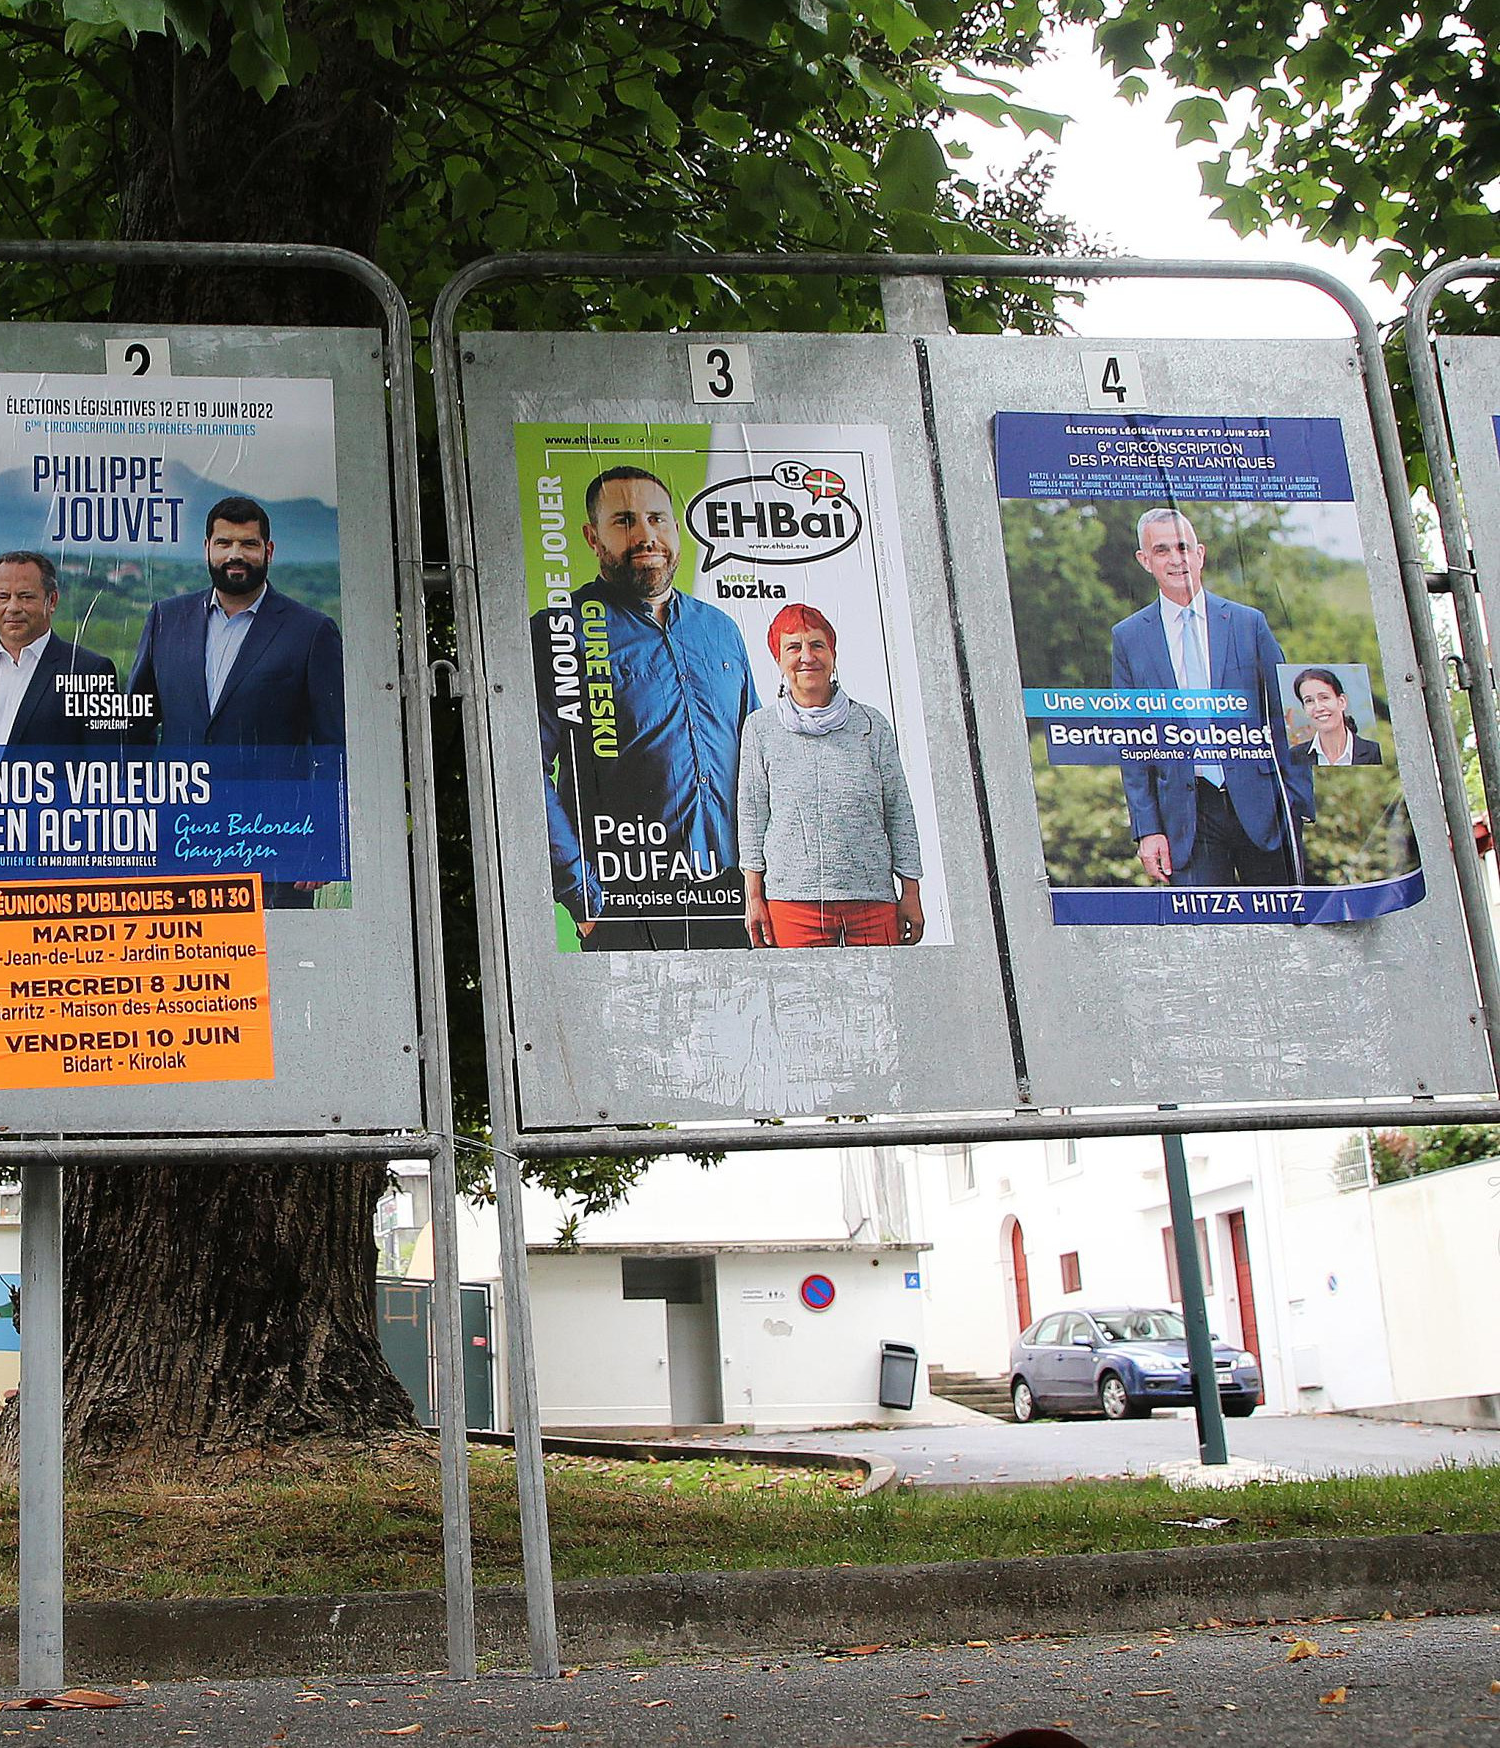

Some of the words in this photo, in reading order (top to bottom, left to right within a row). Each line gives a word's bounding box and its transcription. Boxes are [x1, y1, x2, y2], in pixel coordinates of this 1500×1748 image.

[124, 342, 151, 376] 2
[706, 348, 734, 398] 3
[1100, 357, 1126, 403] 4
[6, 395, 71, 415] ÉLECTIONS
[75, 396, 156, 417] LÉGISLATIVES
[160, 401, 172, 417] 12
[177, 402, 190, 418] ET
[194, 402, 207, 418] 19
[211, 402, 238, 419] JUIN
[241, 403, 273, 419] 2022
[44, 421, 126, 435] CIRCONSCRIPTION
[128, 421, 146, 435] DES
[544, 435, 620, 445] www.ehbai.eus
[1065, 425, 1118, 436] ÉLECTIONS
[1119, 426, 1183, 437] LÉGISLATIVES
[1185, 429, 1196, 437] 12
[1197, 429, 1210, 437] ET
[1224, 429, 1246, 438] JUIN
[1247, 429, 1271, 438] 2022
[1114, 441, 1244, 456] CIRCONSCRIPTION
[1069, 454, 1098, 467] DES
[1101, 452, 1174, 468] PYRÉNÉES
[1177, 456, 1276, 470] ATLANTIQUES
[33, 455, 164, 494] PHILIPPE
[780, 466, 800, 484] 15
[52, 496, 184, 544] JOUVET
[537, 474, 570, 568] JOUER
[705, 499, 846, 539] EHBai
[748, 542, 809, 550] www.ehbai.eus
[716, 579, 787, 599] bozka
[722, 573, 756, 583] votez
[544, 571, 573, 610] DE
[580, 599, 612, 677] GURE
[548, 614, 581, 697] NOUS
[55, 674, 115, 693] PHILIPPE
[65, 694, 154, 717] ELISSALDE
[557, 700, 583, 725] A
[1043, 693, 1085, 711] Une
[1089, 693, 1131, 711] voix
[1135, 693, 1166, 714] qui
[1171, 694, 1248, 714] compte
[90, 718, 128, 730] SUPPLÉANT
[587, 682, 619, 759] ESKU
[1050, 724, 1159, 745] Bertrand
[1164, 724, 1273, 745] Soubelet
[1121, 749, 1185, 760] Suppléante
[1193, 748, 1228, 760] Anne
[65, 761, 211, 805] VALEURS
[39, 808, 157, 852] ACTION
[174, 813, 221, 838] Gure
[227, 812, 315, 837] Baloreak
[593, 814, 668, 846] Peio
[25, 855, 36, 867] DE
[37, 855, 48, 867] LA
[49, 854, 90, 867] MAJORITÉ
[91, 854, 157, 867] PRÉSIDENTIELLE
[174, 837, 278, 868] Gauzatzen
[596, 850, 718, 883] DUFAU
[77, 889, 174, 914] PUBLIQUES
[188, 889, 207, 908] 18
[211, 888, 224, 907] H
[227, 887, 251, 907] 30
[601, 890, 673, 909] Françoise
[676, 889, 742, 905] GALLOIS
[1172, 893, 1244, 915] HITZA
[1252, 892, 1305, 914] HITZ
[32, 924, 115, 944] MARDI
[124, 923, 138, 941] 7
[145, 921, 203, 940] JUIN
[120, 943, 170, 962] Jardin
[174, 943, 257, 963] Botanique
[10, 976, 142, 998] MERCREDI
[150, 975, 165, 993] 8
[172, 973, 230, 992] JUIN
[61, 1000, 117, 1019] Maison
[122, 998, 151, 1016] des
[156, 995, 258, 1014] Associations
[5, 1030, 139, 1053] VENDREDI
[147, 1029, 174, 1047] 10
[181, 1026, 240, 1046] JUIN
[63, 1055, 113, 1074] Bidart
[129, 1051, 187, 1071] Kirolak
